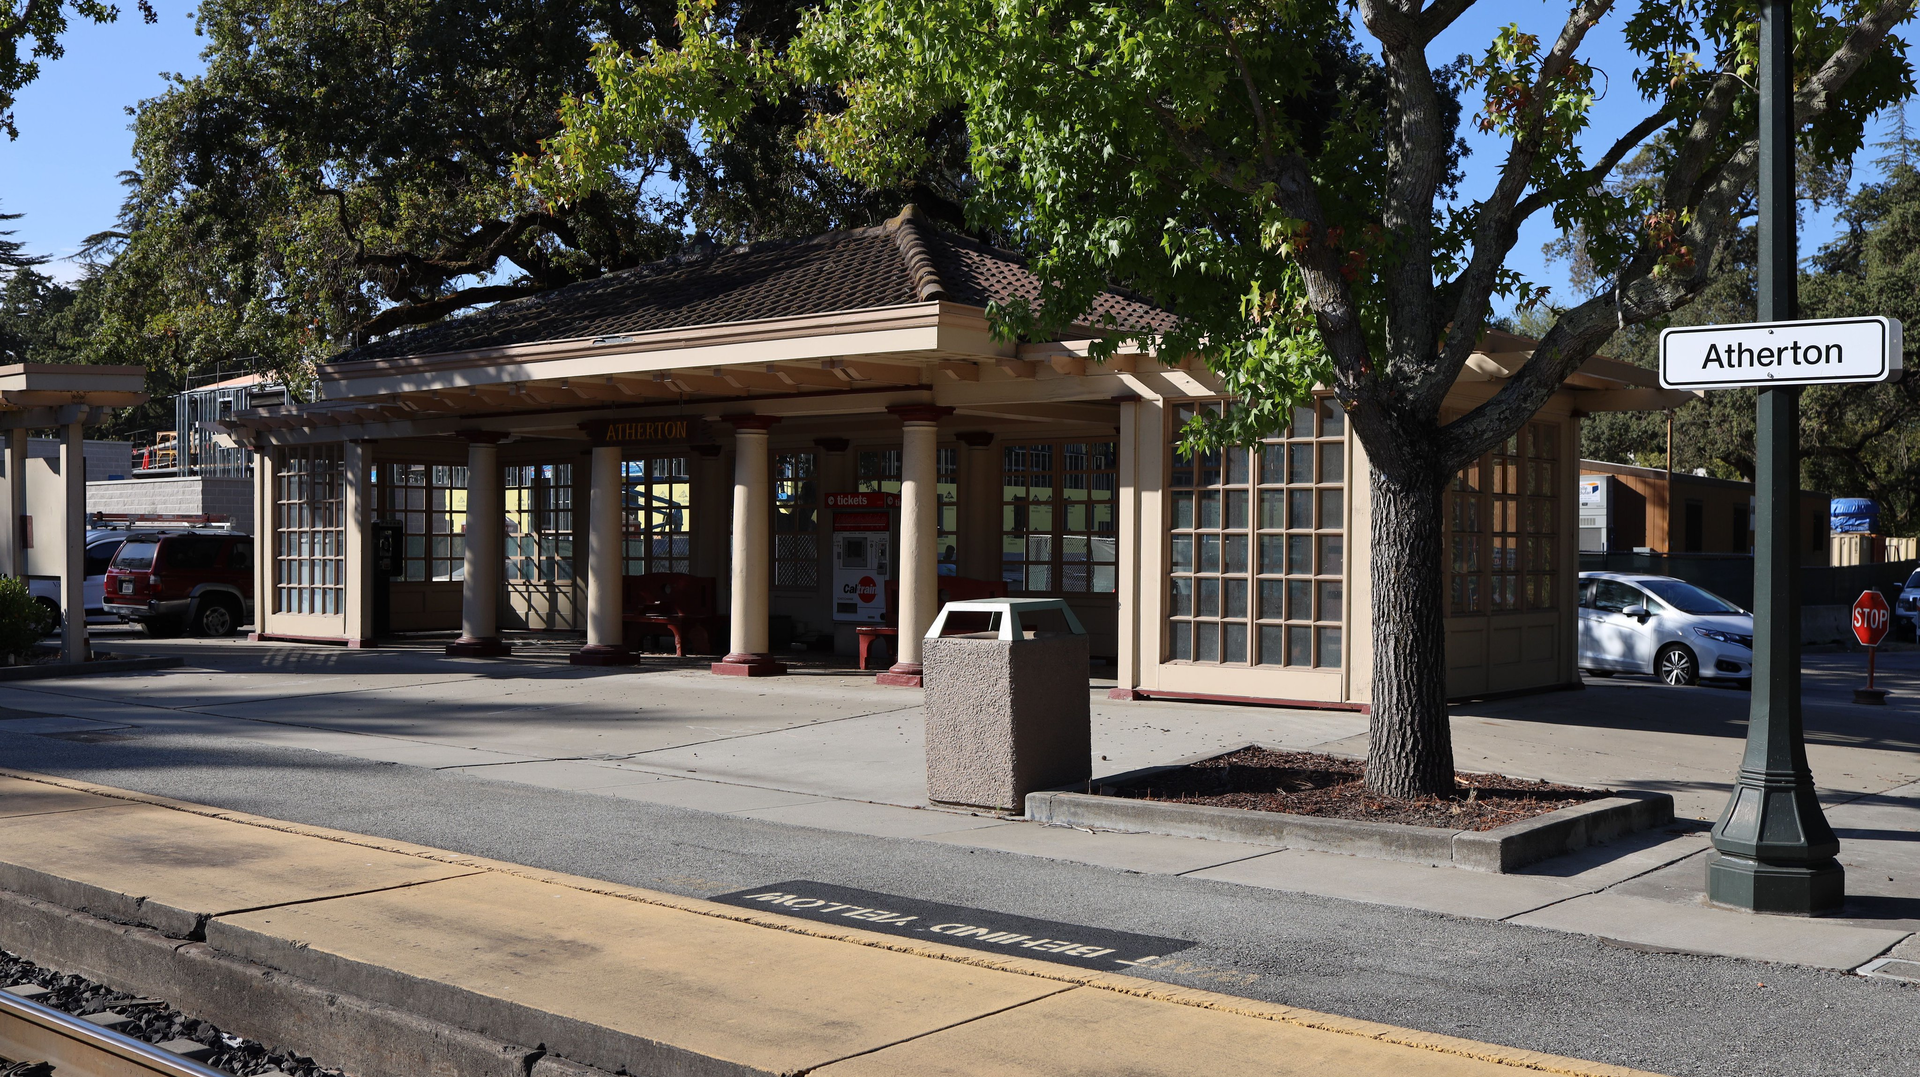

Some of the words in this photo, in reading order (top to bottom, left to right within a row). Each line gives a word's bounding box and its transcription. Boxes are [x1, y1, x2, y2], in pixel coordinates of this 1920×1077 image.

[1701, 340, 1843, 370] Atherton
[605, 420, 688, 441] ATHERTON
[836, 494, 868, 506] tickets
[843, 583, 877, 595] Caltrain
[1854, 607, 1888, 629] STOP
[742, 891, 919, 927] YELLOW
[926, 920, 1117, 960] BEHIND
